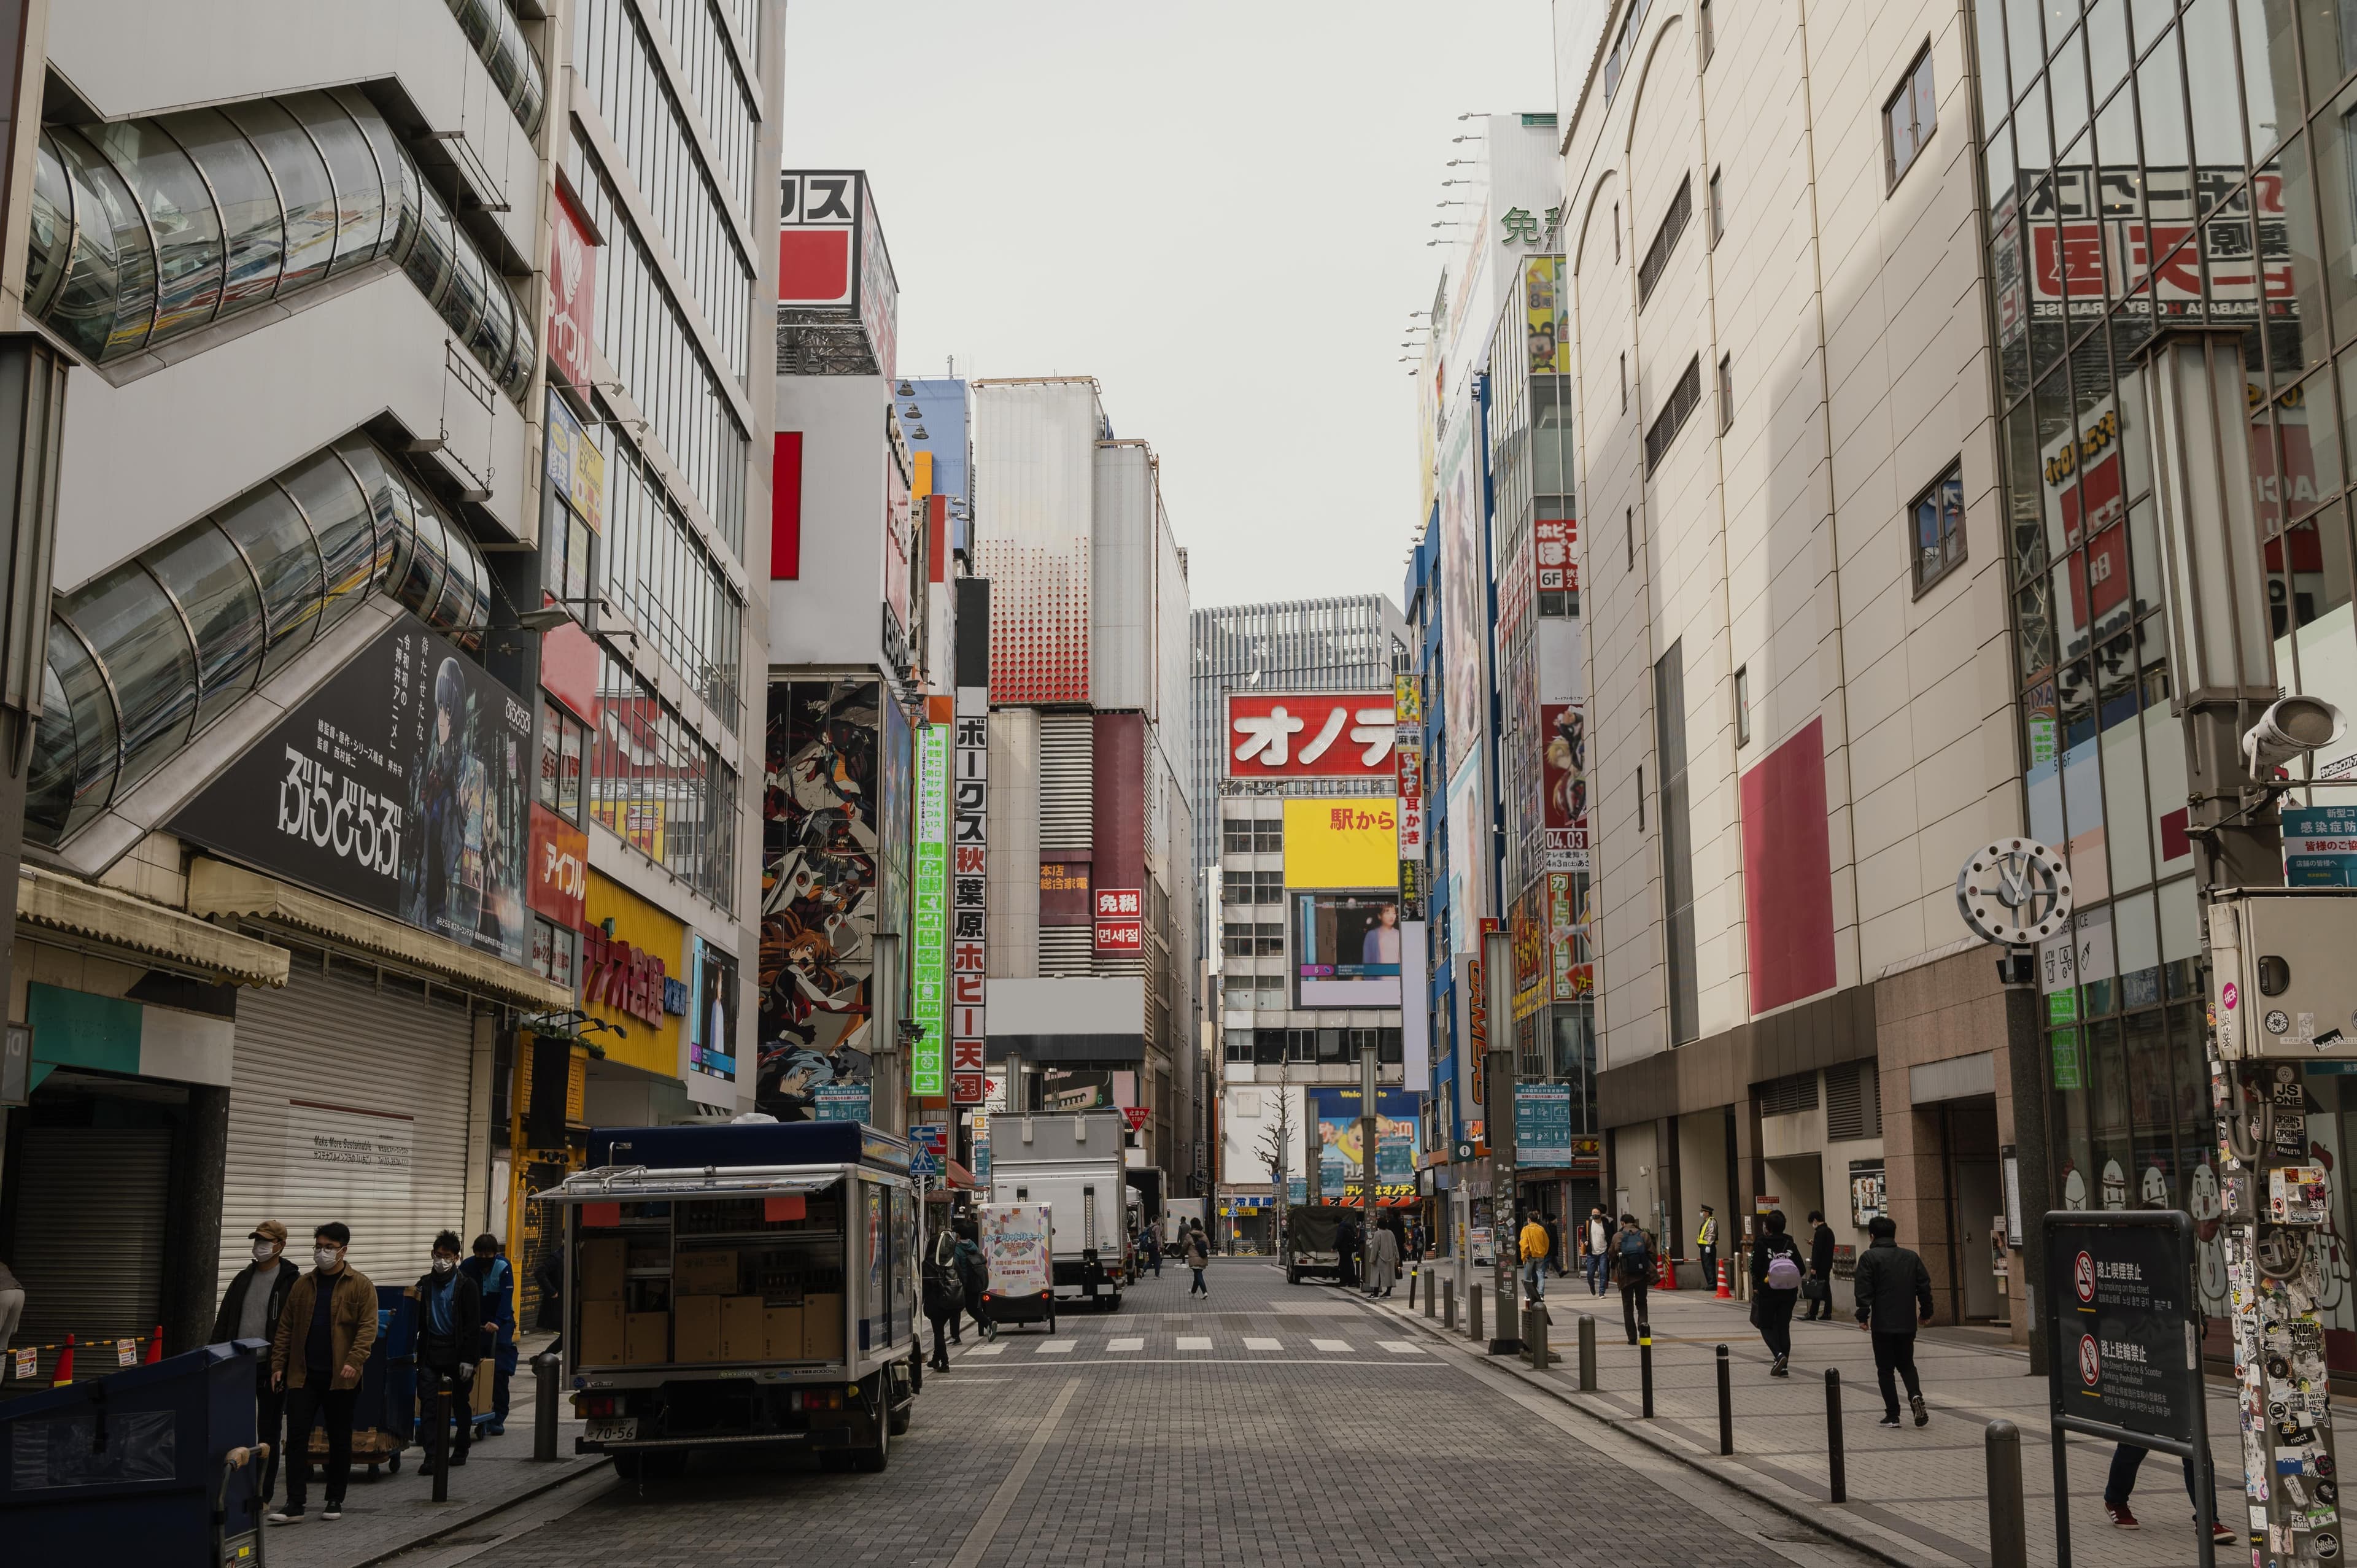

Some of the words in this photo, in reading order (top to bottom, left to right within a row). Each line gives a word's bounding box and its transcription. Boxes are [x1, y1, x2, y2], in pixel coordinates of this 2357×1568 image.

[1542, 572, 1561, 586] 6F
[400, 634, 411, 706] 令和初の
[390, 637, 403, 751] 「押井アニメ」
[417, 636, 429, 754] 待たせたな。
[317, 736, 328, 755] 監督
[1398, 736, 1420, 745] 麻雀
[1330, 808, 1395, 830] 駅から
[1405, 798, 1420, 845] 耳かき
[2301, 821, 2356, 833] 感染症防
[1546, 831, 1584, 849] 04.03
[544, 841, 586, 902] アイフル
[1040, 864, 1065, 877] 本店
[1040, 877, 1088, 890] 総合家電
[1099, 894, 1137, 913] 免税
[1098, 929, 1139, 944] 면세점
[2045, 949, 2055, 959] ATM
[2224, 987, 2237, 1005] HEX
[2277, 1084, 2299, 1096] JS
[2275, 1096, 2302, 1105] ONE
[314, 1135, 328, 1148] Make
[329, 1137, 343, 1149] More
[343, 1138, 372, 1152] Sustainable
[1346, 1184, 1416, 1196] テレはオノデン
[2097, 1261, 2142, 1281] 路上喫煙禁止
[2097, 1281, 2104, 1291] No
[2104, 1281, 2122, 1294] smoking
[2122, 1283, 2128, 1292] on
[2137, 1284, 2150, 1294] street
[2100, 1339, 2147, 1363] 路上駐輪禁止
[2101, 1359, 2123, 1372] On-Street
[2123, 1363, 2139, 1375] Bicycle
[2145, 1367, 2162, 1378] Scooter
[2102, 1370, 2119, 1383] Parking
[2119, 1374, 2143, 1386] Prohibited
[595, 1427, 634, 1440] 70-56
[2290, 1433, 2308, 1444] noct
